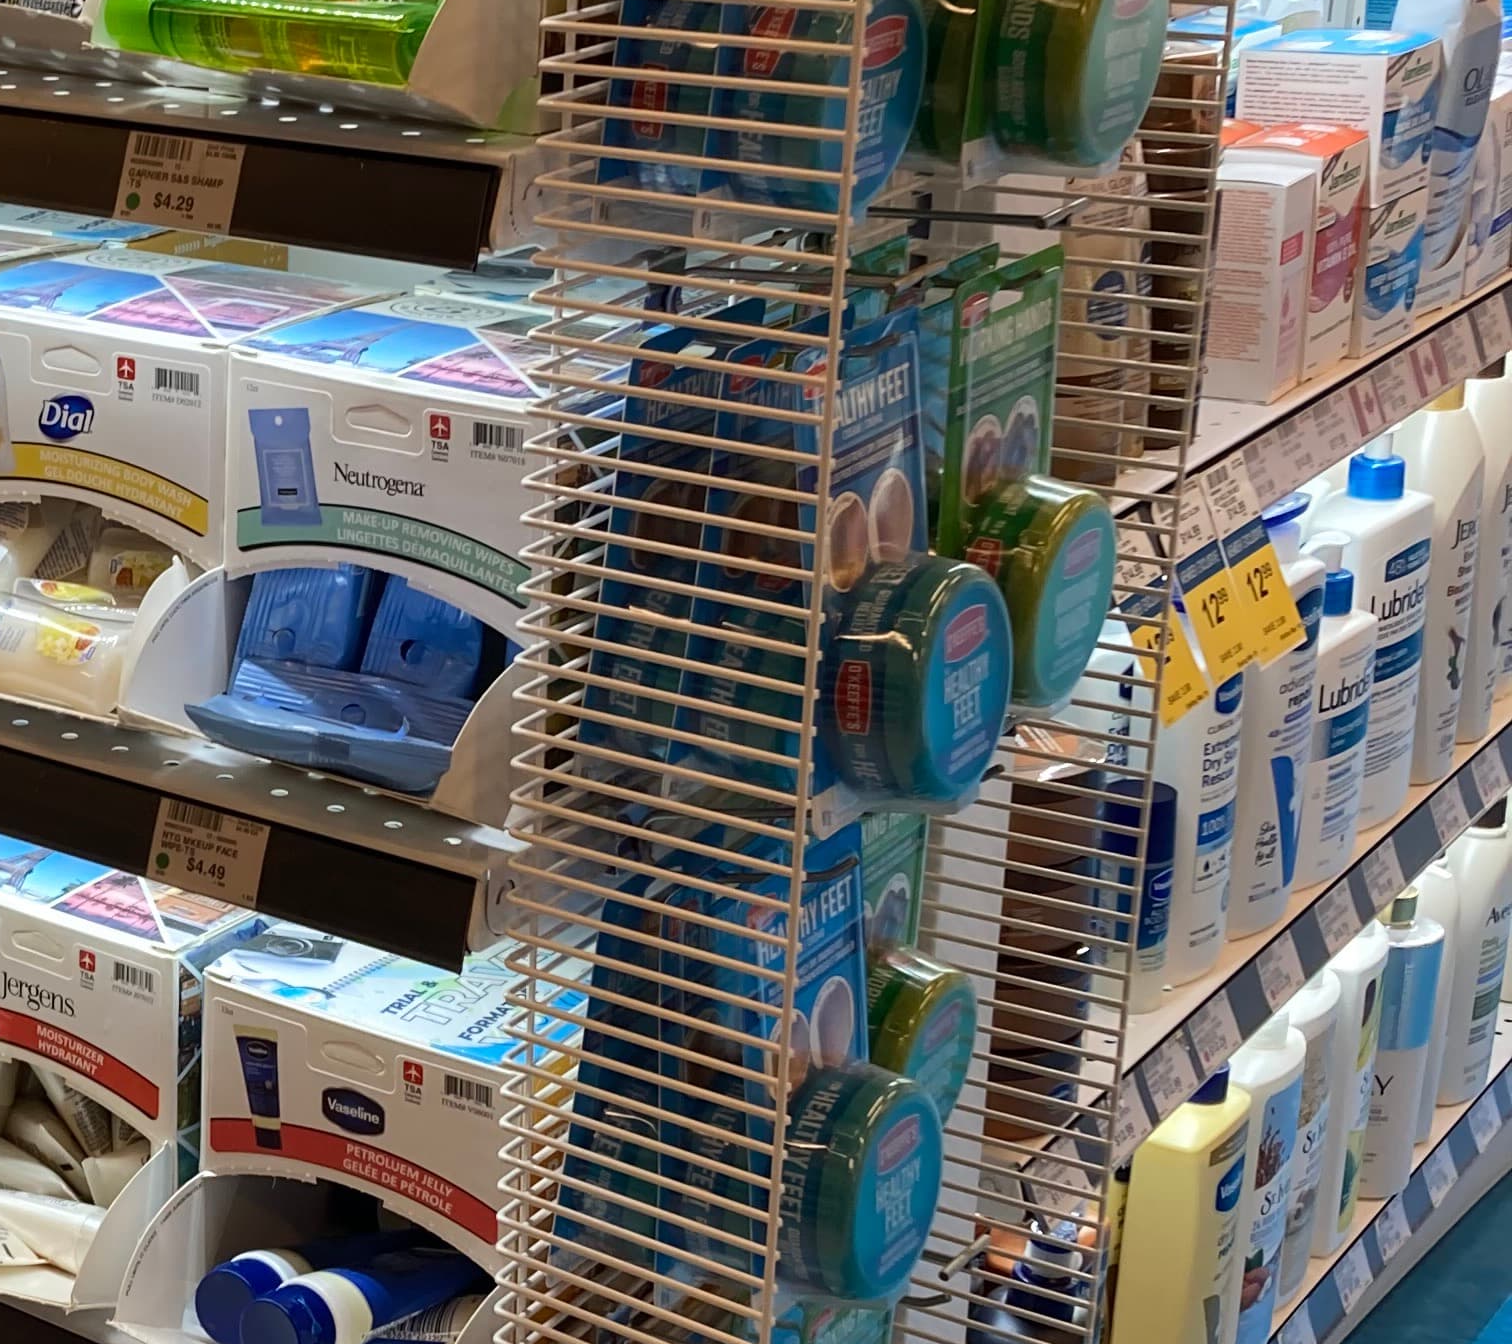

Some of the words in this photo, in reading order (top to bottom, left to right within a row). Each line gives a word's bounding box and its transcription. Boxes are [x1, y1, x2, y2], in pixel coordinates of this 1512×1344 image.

[128, 168, 169, 182] GARNIER
[192, 175, 223, 188] SHAMP
[153, 191, 194, 212] $4.29
[878, 363, 911, 401] FEET
[41, 400, 94, 434] Dial
[432, 440, 449, 451] TSA
[40, 450, 121, 479] MOISTURIZING
[123, 469, 155, 490] BODY
[158, 482, 192, 507] WASH
[45, 465, 64, 479] GEL
[67, 470, 114, 491] DOUCHE
[116, 482, 184, 519] HYDRATANT
[334, 462, 425, 497] Neutrogena
[337, 527, 399, 551] LINGETTES
[402, 539, 516, 595] DÉMAQUILLANTES
[343, 511, 399, 531] MAKE-UP
[402, 521, 471, 555] REMOVING
[476, 548, 514, 576] WIPES
[952, 685, 982, 733] FEET
[186, 857, 225, 880] $4.49
[216, 844, 238, 859] FACE
[814, 875, 853, 923] FEET
[380, 987, 421, 1016] TRIAL
[422, 980, 438, 993] &
[37, 1025, 104, 1067] MOISTURIZER
[38, 1039, 98, 1075] HYDRATANT
[405, 1084, 422, 1096] TSA
[327, 1096, 380, 1125] Vaseline
[343, 1156, 379, 1180] GELÉE
[382, 1172, 397, 1188] DE
[399, 1178, 452, 1216] PÉTROLE
[346, 1144, 419, 1182] PETROLUEM
[421, 1172, 453, 1198] JELLY
[884, 1190, 914, 1240] FEET
